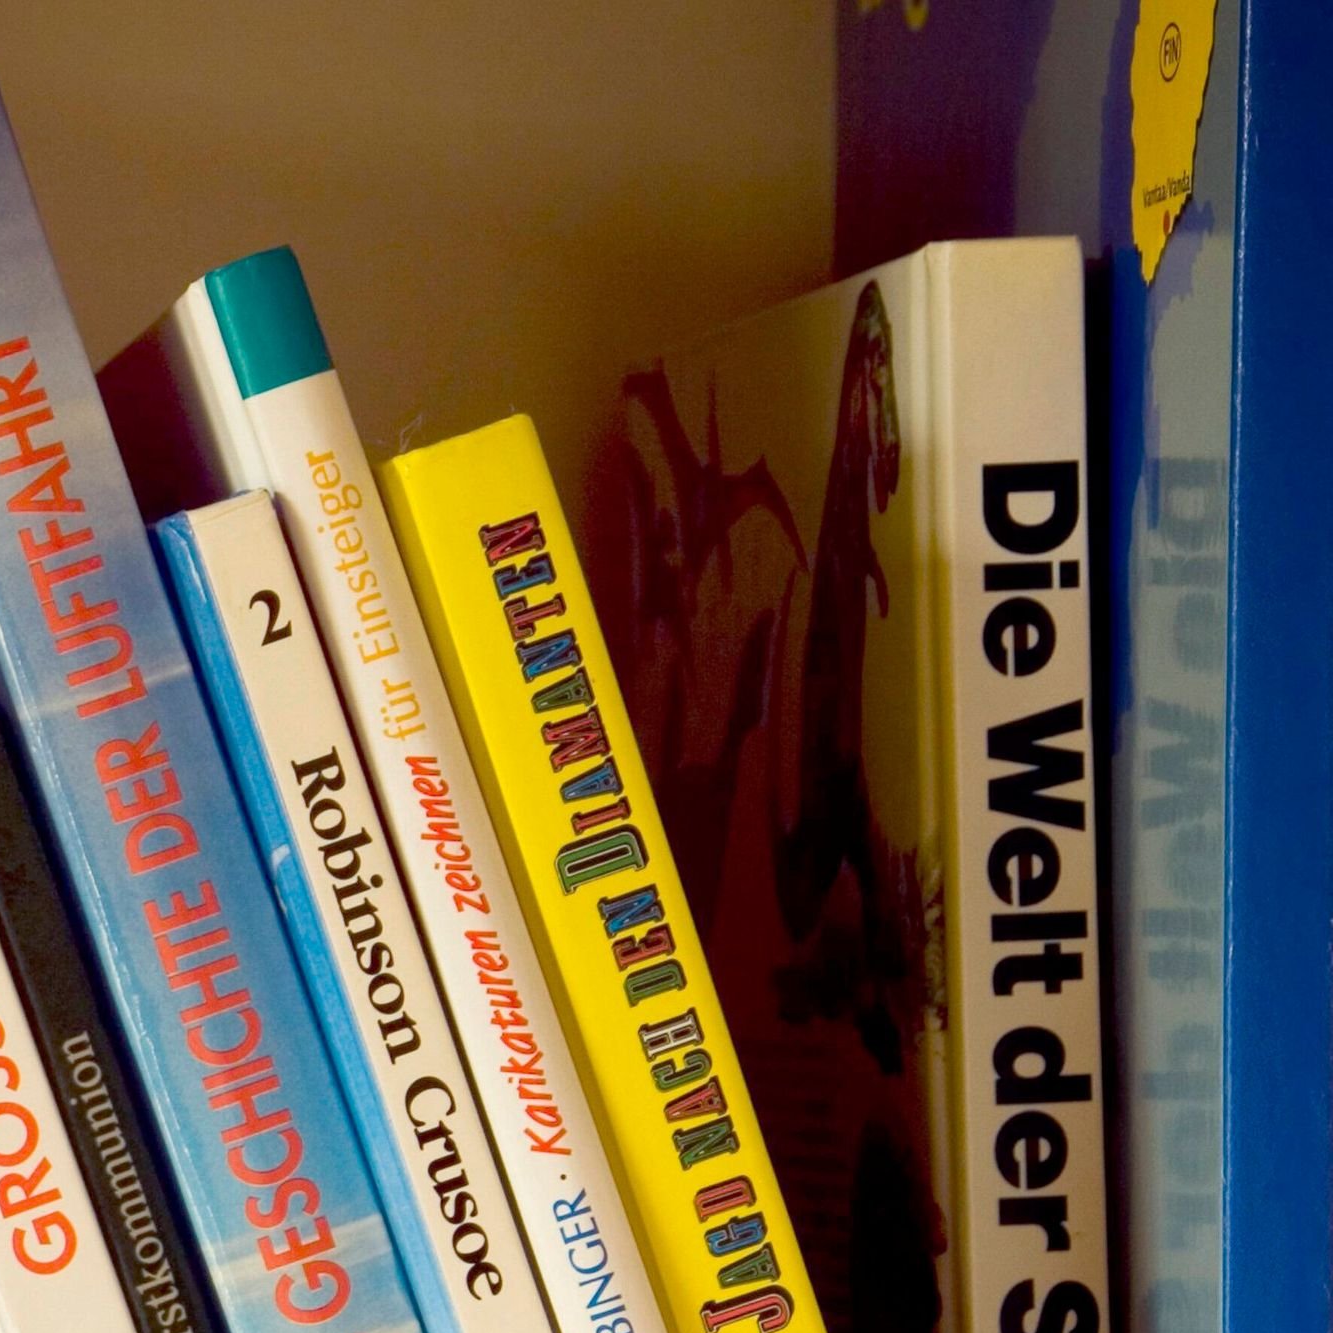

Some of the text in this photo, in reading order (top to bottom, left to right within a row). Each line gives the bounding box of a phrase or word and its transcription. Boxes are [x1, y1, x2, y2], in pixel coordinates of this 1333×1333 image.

[306, 450, 402, 664] Einsteiger
[981, 460, 1081, 678] Die
[92, 720, 201, 877] DER
[381, 677, 427, 742] für
[478, 511, 649, 896] DIAMANTEN
[405, 755, 490, 914] zeichnen
[597, 880, 688, 1003] DEN
[985, 698, 1088, 997] Welt
[248, 588, 504, 1302] 2 Robinson Crusoe
[466, 928, 572, 1158] Karikaturen
[144, 880, 351, 1325] GESCHICHTE
[637, 1007, 741, 1170] NACH
[991, 1026, 1093, 1252] der
